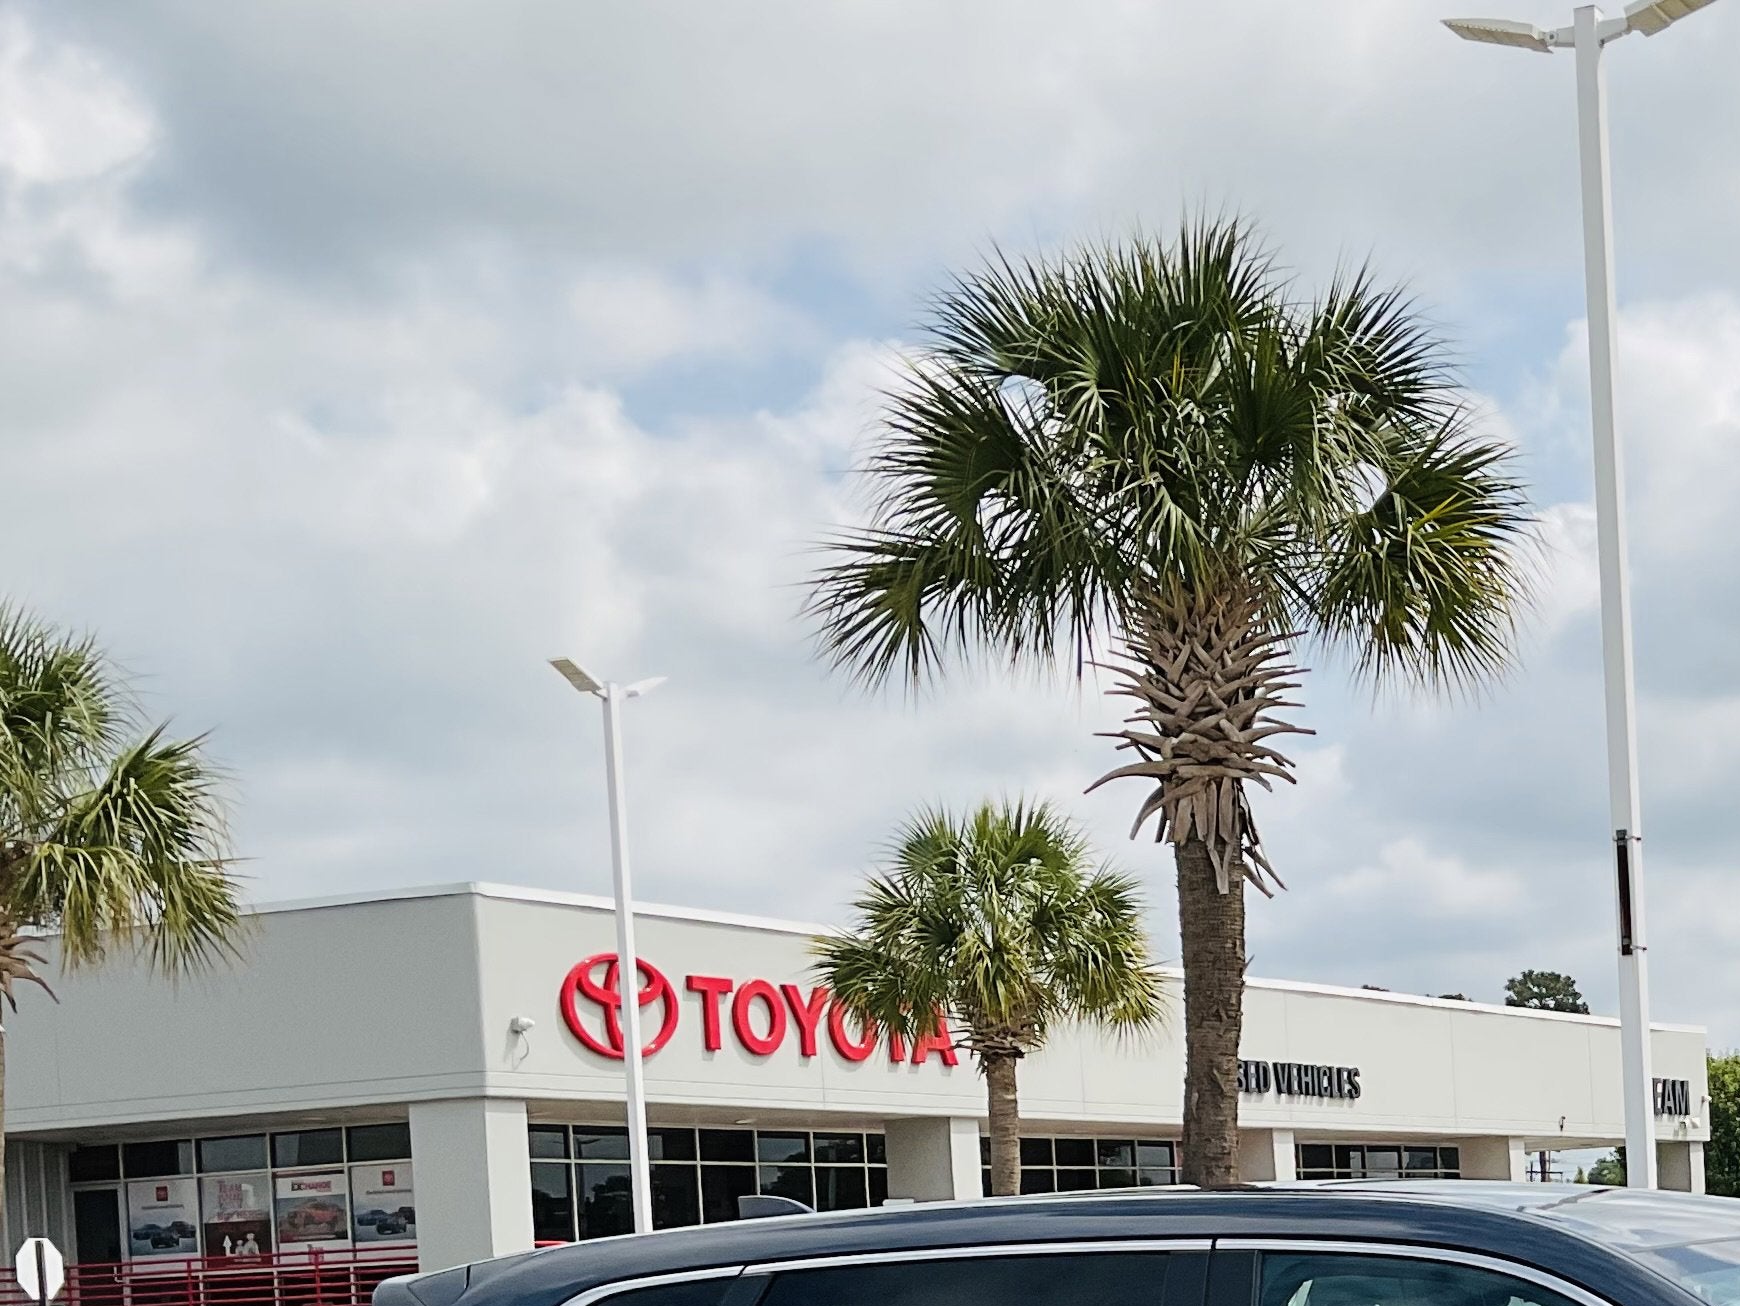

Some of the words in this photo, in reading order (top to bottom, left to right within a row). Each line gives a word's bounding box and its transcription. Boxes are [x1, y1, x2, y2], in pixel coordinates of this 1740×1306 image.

[1238, 1060, 1270, 1094] SED
[1272, 1062, 1361, 1099] VEHICLES
[1652, 1078, 1690, 1115] EAM
